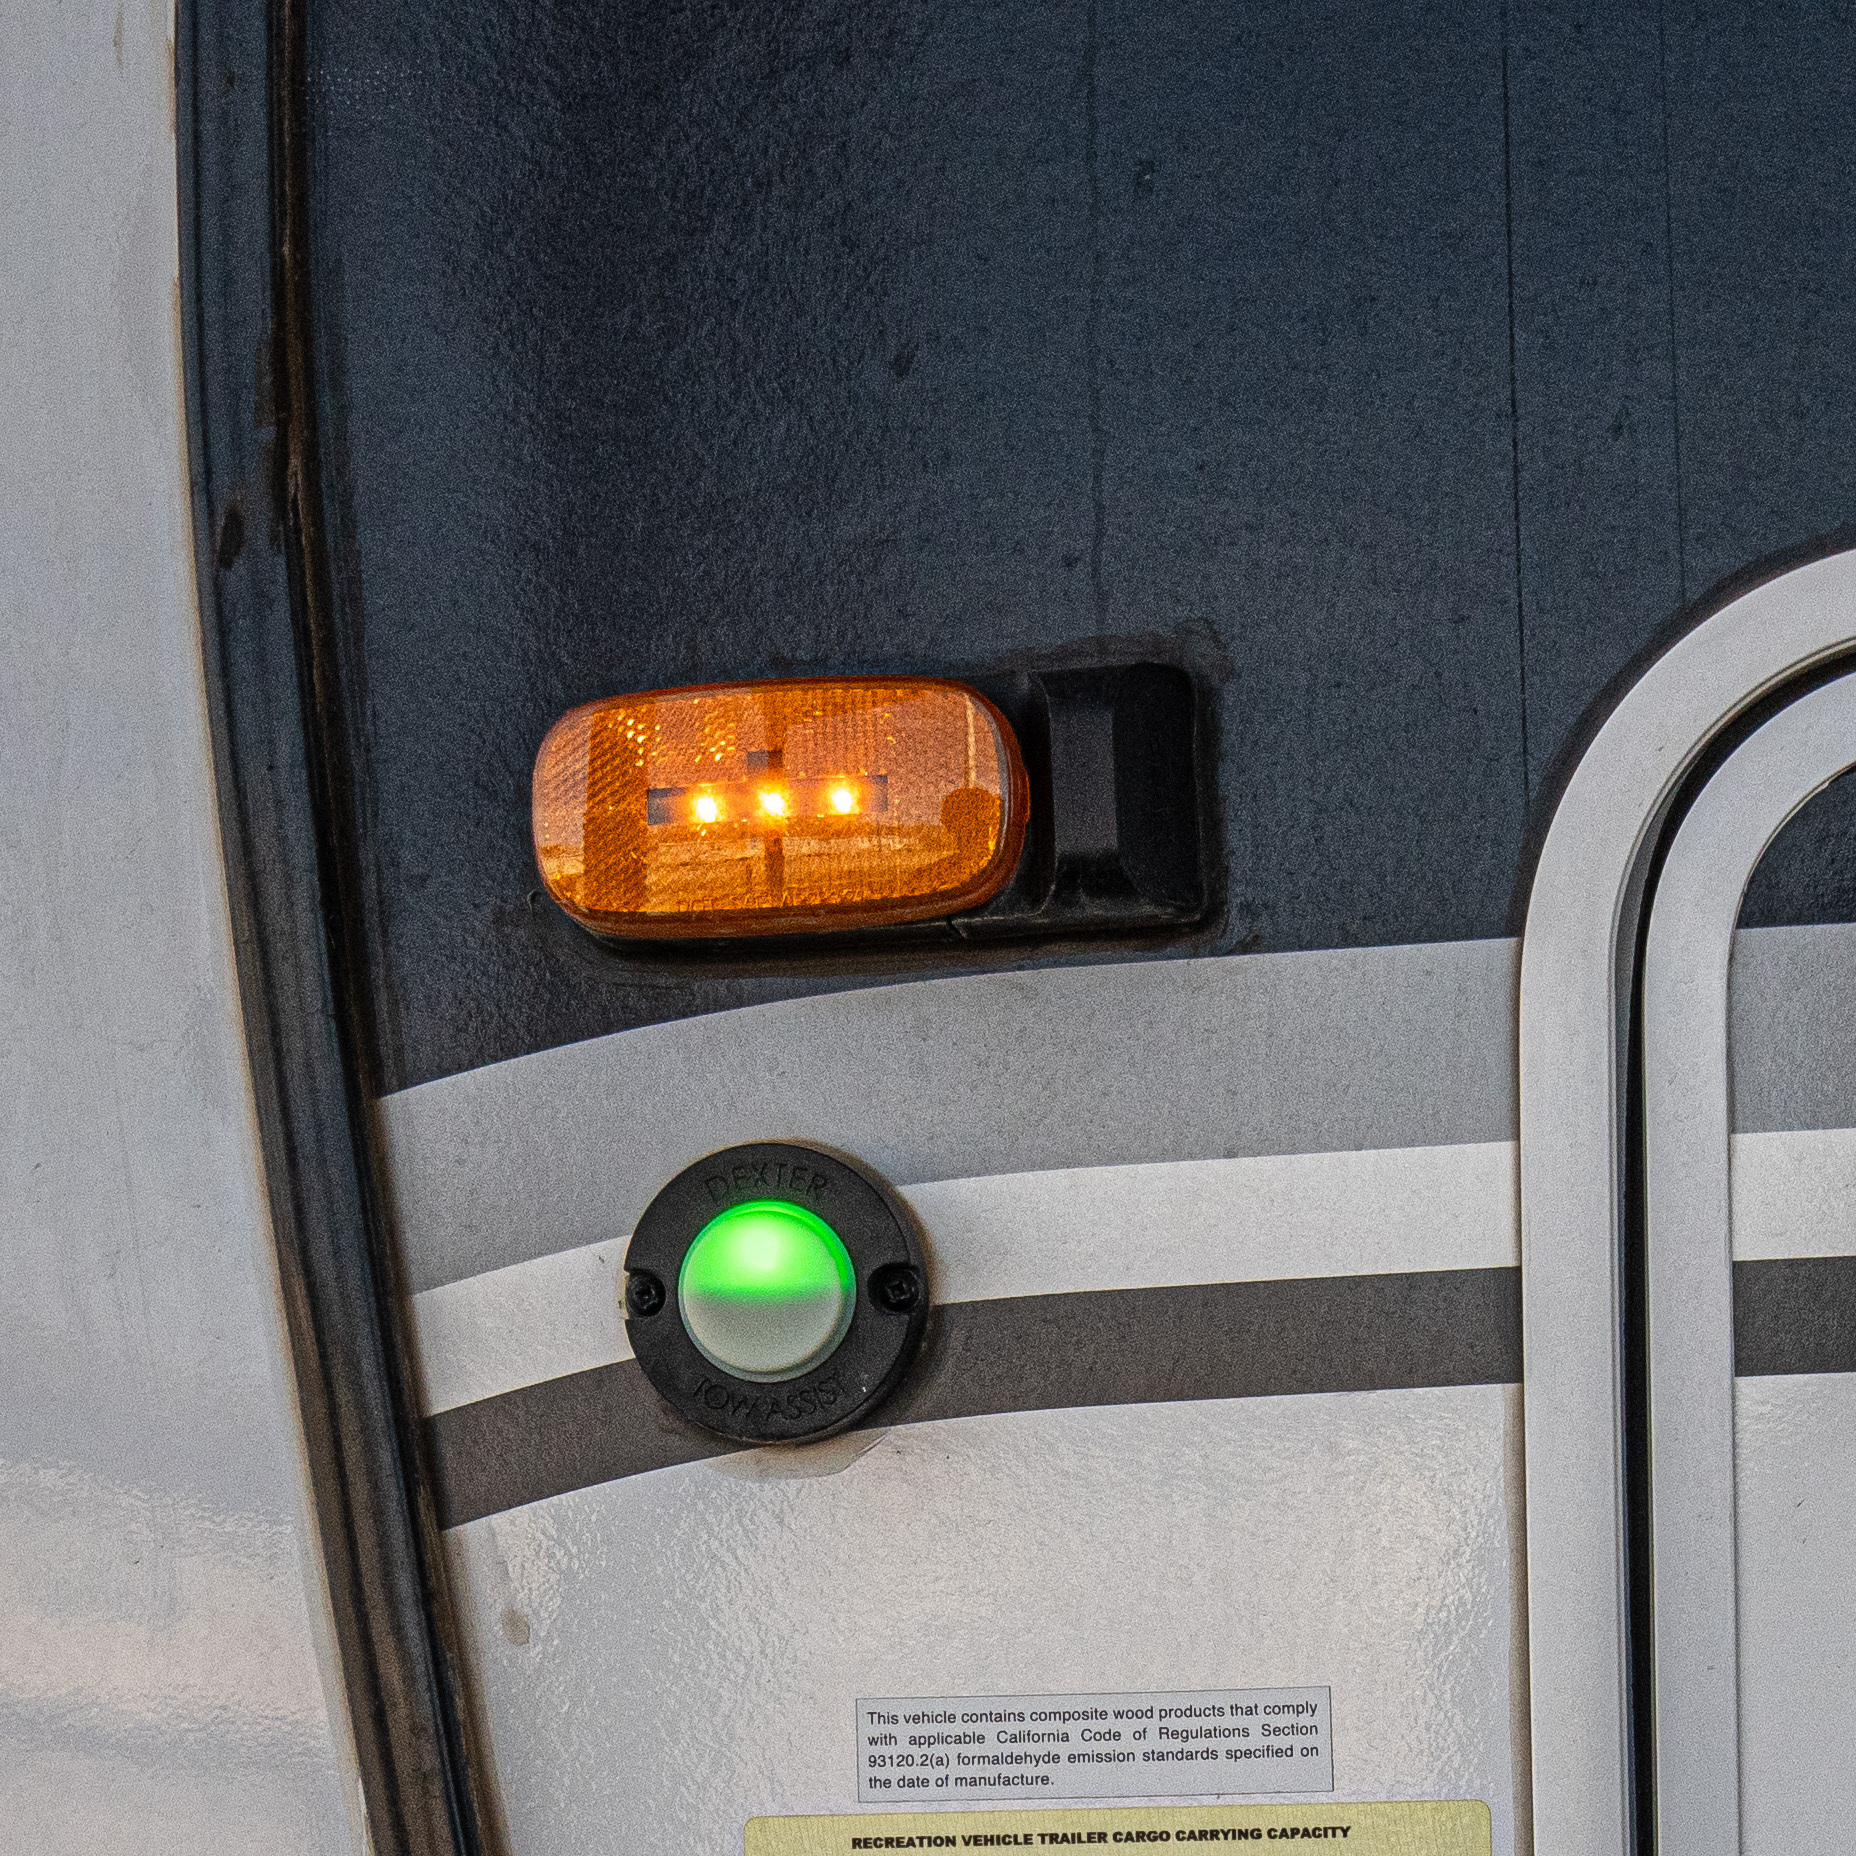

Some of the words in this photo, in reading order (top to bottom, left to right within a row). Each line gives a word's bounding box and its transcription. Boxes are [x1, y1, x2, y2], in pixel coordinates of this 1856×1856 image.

[703, 1161, 829, 1204] DEXTER
[692, 1372, 761, 1419] TOW
[764, 1370, 848, 1420] ASSIST
[866, 1710, 900, 1726] This
[902, 1710, 957, 1725] vehicle
[960, 1709, 1026, 1724] contains
[1029, 1707, 1109, 1725] composite
[1112, 1705, 1155, 1720] wood
[1158, 1704, 1226, 1722] products
[1229, 1703, 1259, 1717] that
[1262, 1700, 1318, 1718] comply
[867, 1732, 898, 1747] with
[908, 1731, 986, 1749] applicable
[996, 1729, 1070, 1745] California
[1080, 1727, 1122, 1743] Code
[1132, 1726, 1148, 1742] of
[1158, 1725, 1251, 1744] Regulations
[1261, 1722, 1319, 1738] Section
[867, 1753, 950, 1769] 93120.2(a)
[956, 1750, 1061, 1768] formaldehyde
[1066, 1749, 1136, 1764] emission
[1142, 1746, 1219, 1763] standards
[1225, 1744, 1294, 1763] specified
[1299, 1745, 1320, 1758] on
[867, 1775, 893, 1790] the
[896, 1775, 931, 1789] date
[934, 1773, 950, 1788] of
[954, 1772, 1055, 1788] manufacture.
[851, 1835, 957, 1850] RECREATION
[961, 1833, 1034, 1847] VEHICLE
[1037, 1831, 1108, 1845] TRAILER
[1112, 1830, 1172, 1844] CARGO
[1174, 1827, 1263, 1842] CARRYING
[1266, 1825, 1352, 1840] CAPACITY
